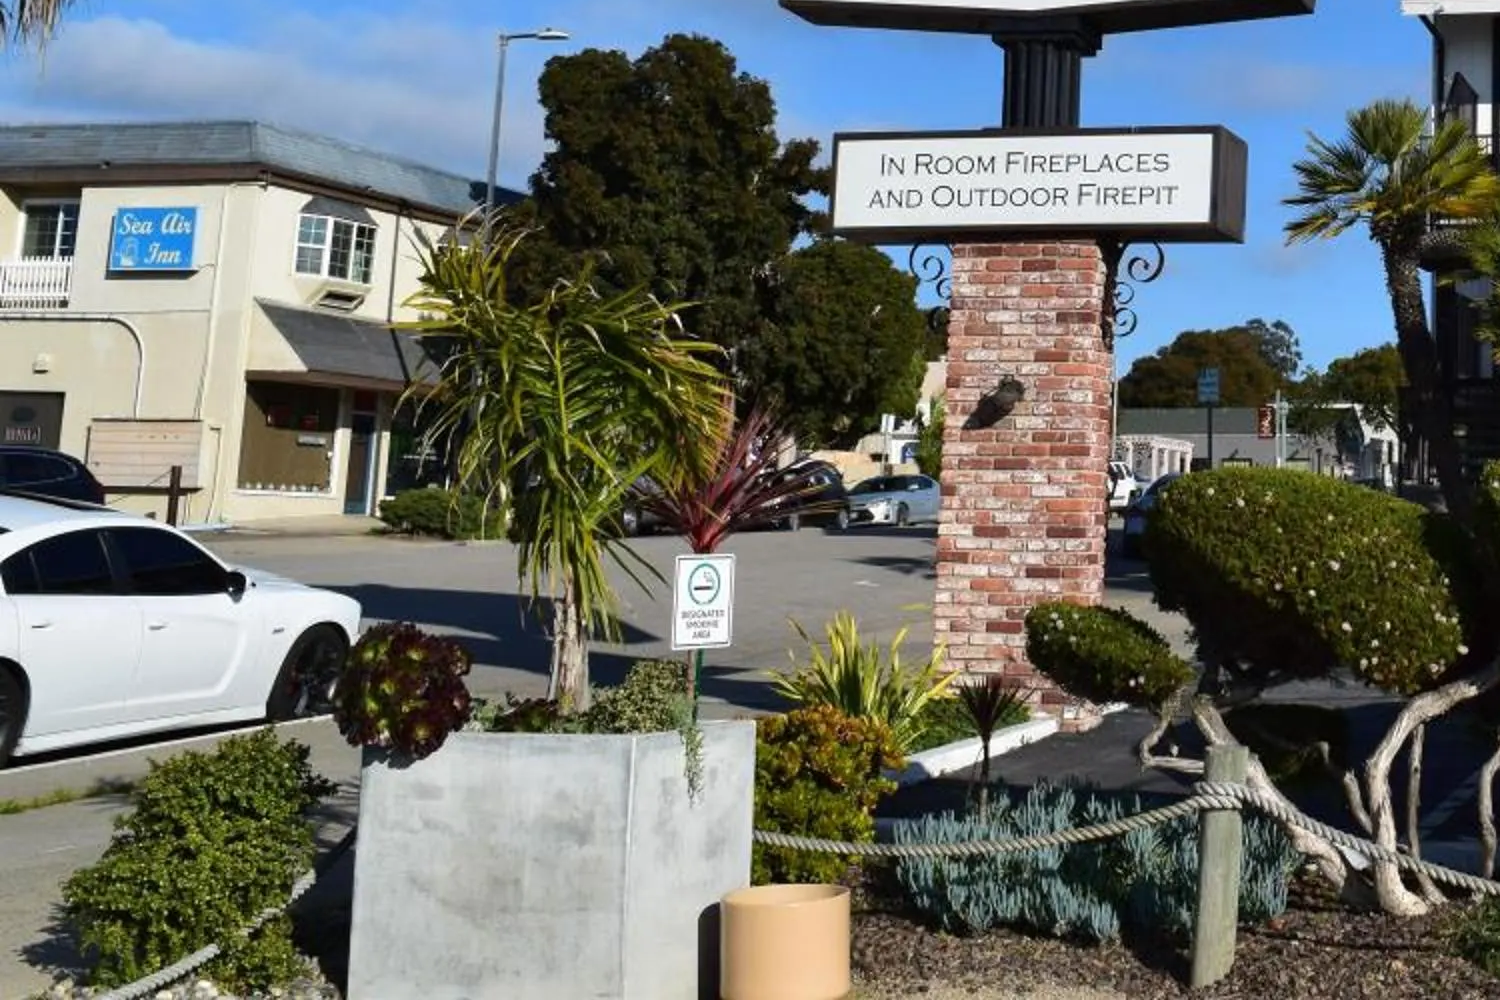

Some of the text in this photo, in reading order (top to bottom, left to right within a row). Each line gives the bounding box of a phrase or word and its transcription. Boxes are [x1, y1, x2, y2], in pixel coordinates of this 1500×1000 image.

[879, 151, 1170, 177] IN ROOM FIREPLACES
[868, 183, 1179, 209] AND OUTDOOR FIREPIT
[118, 212, 192, 236] Sea Air
[143, 241, 182, 264] Inn
